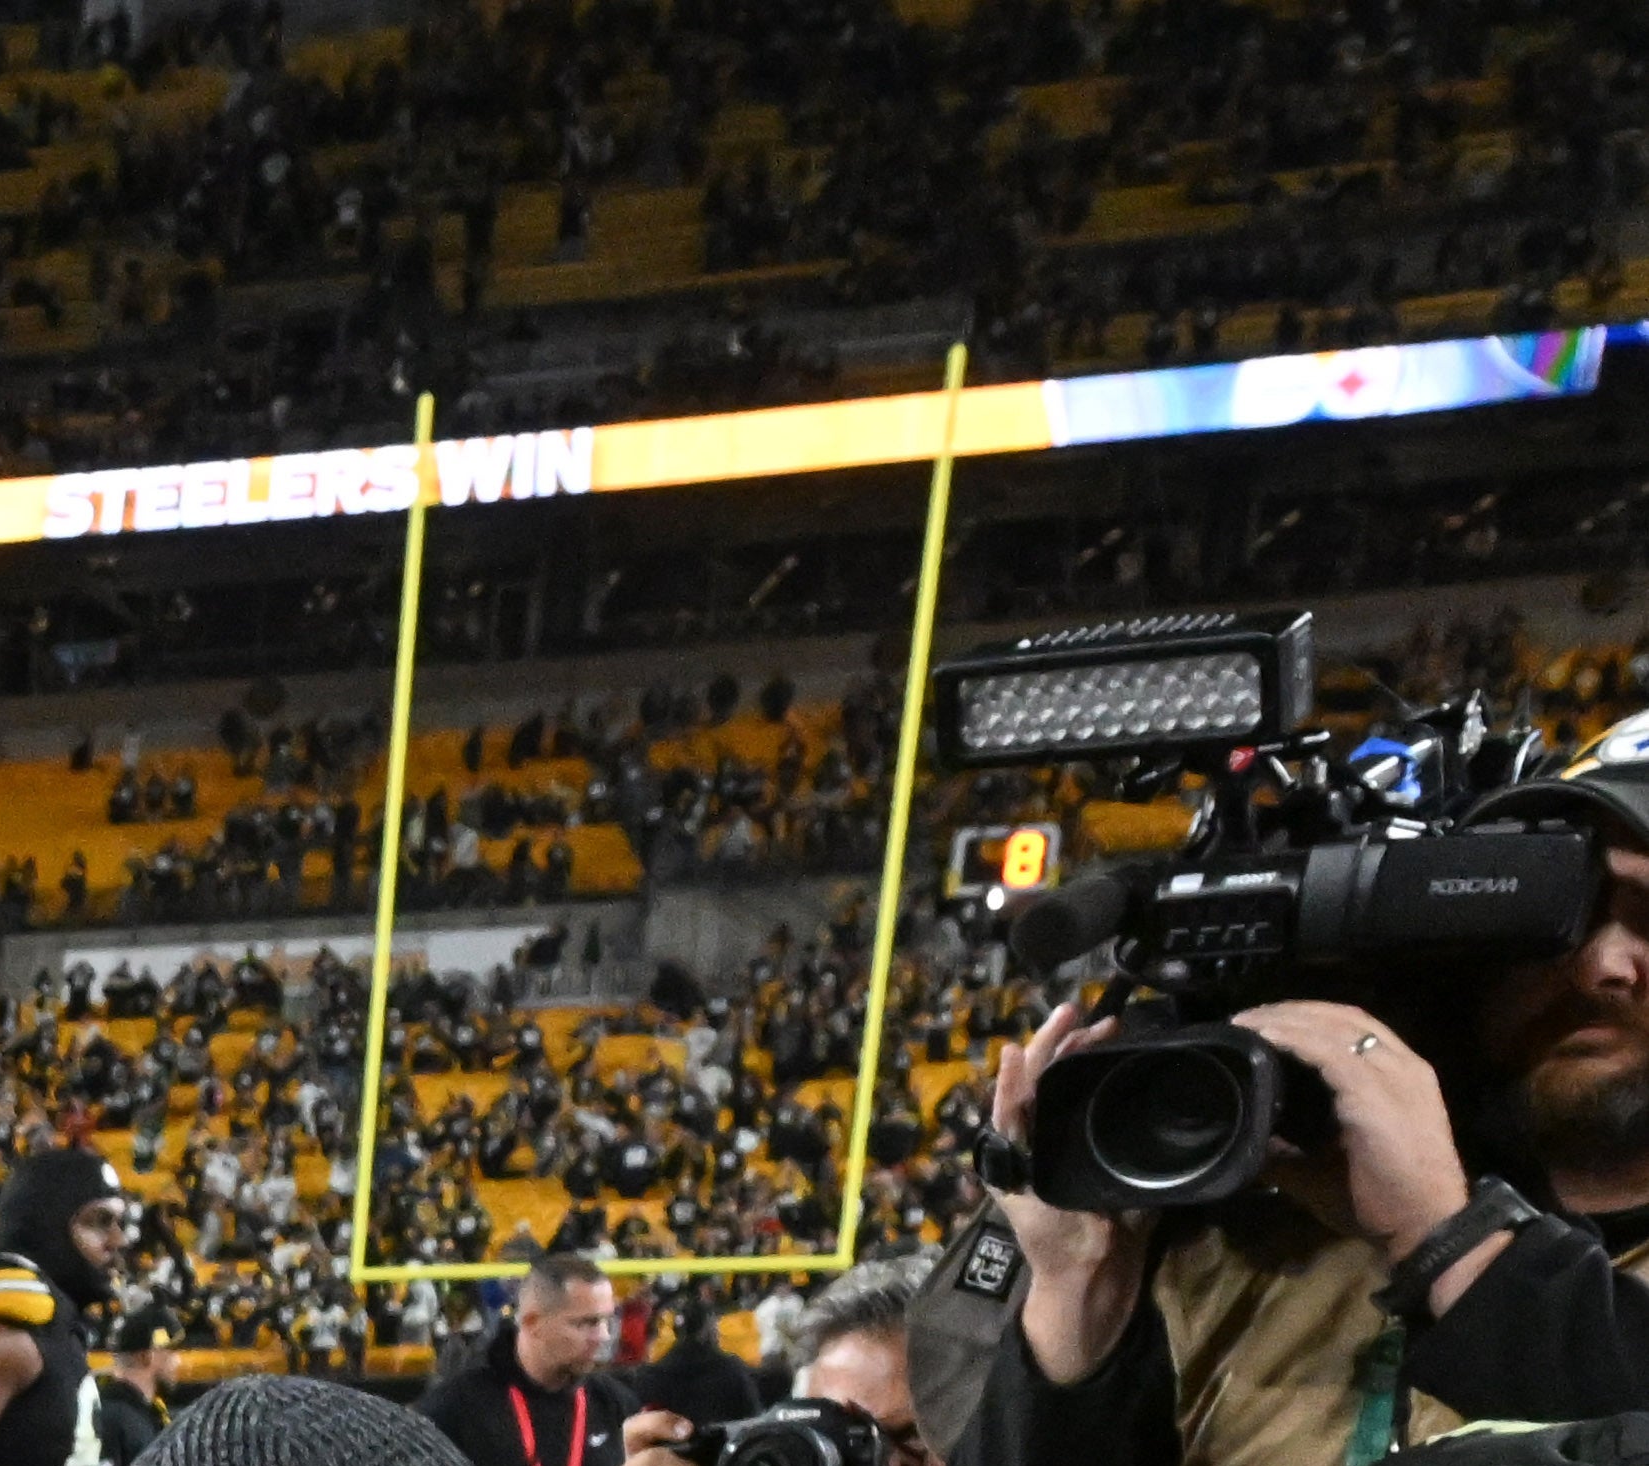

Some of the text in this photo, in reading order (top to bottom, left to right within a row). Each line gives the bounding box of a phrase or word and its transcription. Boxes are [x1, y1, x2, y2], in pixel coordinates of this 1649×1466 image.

[43, 427, 593, 538] STEELERS WIN
[1001, 828, 1048, 889] 8
